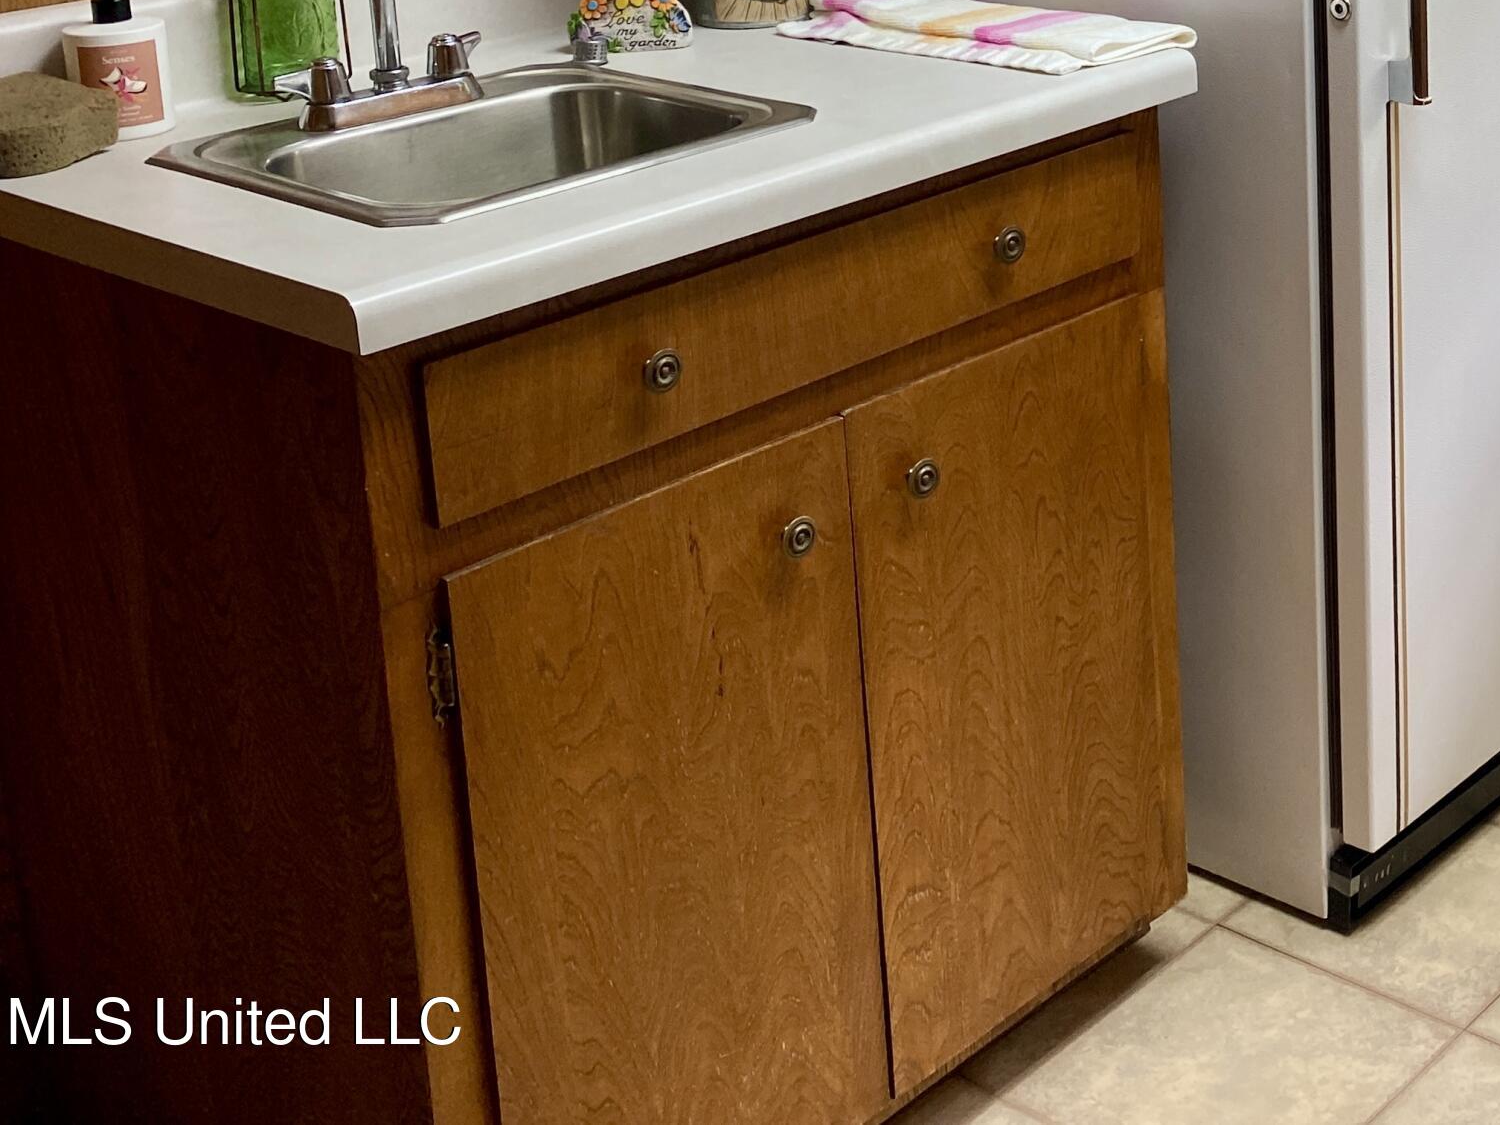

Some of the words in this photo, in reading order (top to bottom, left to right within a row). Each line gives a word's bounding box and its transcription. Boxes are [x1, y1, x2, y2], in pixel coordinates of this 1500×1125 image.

[602, 11, 646, 28] Love
[616, 28, 638, 40] my
[625, 36, 677, 52] garden
